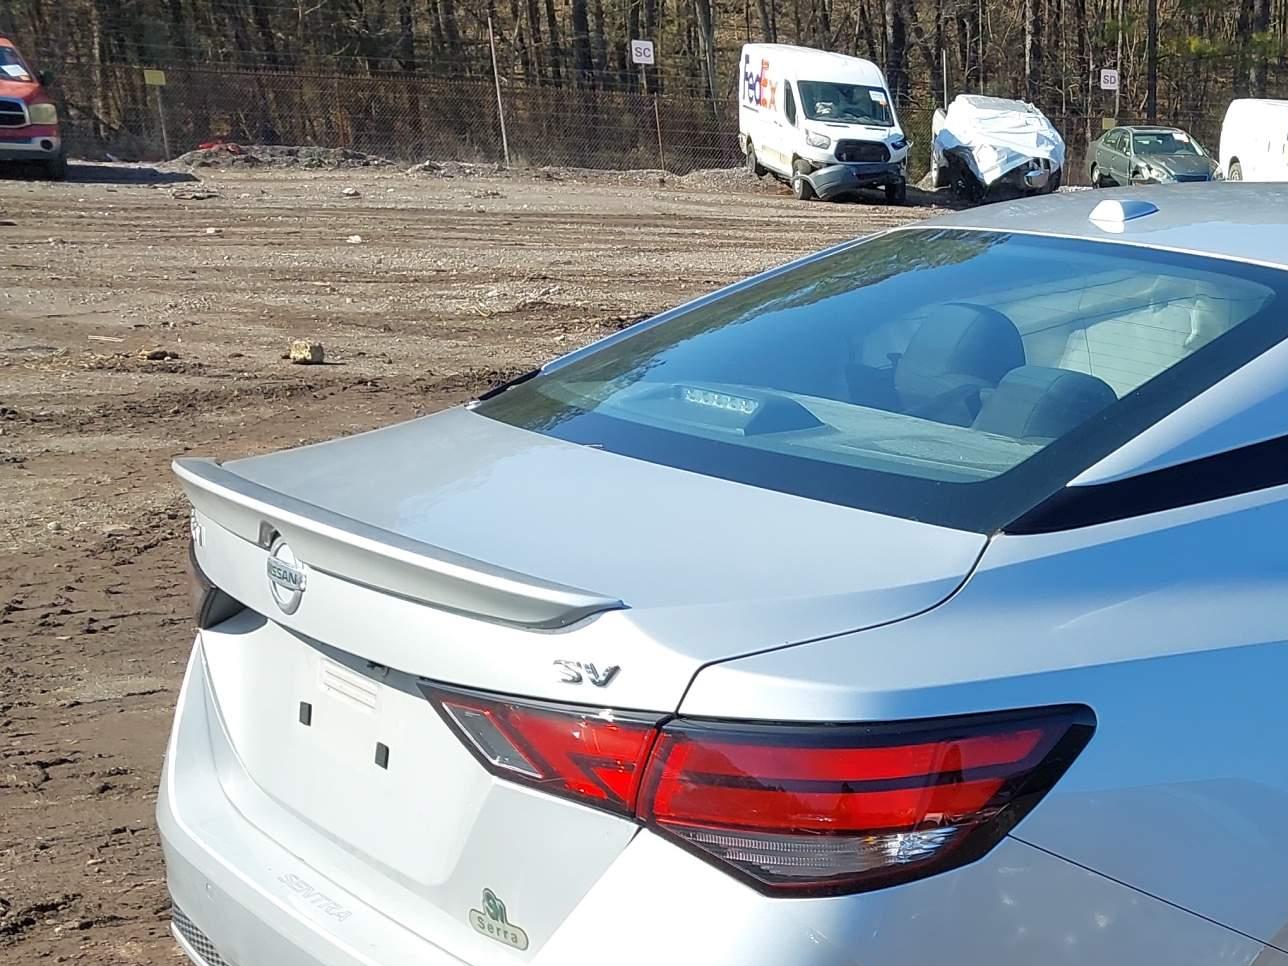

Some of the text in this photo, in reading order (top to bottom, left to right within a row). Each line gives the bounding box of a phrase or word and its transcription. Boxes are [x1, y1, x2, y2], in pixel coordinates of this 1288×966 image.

[634, 46, 651, 58] SC
[743, 54, 778, 112] FedEx
[1103, 74, 1116, 85] SD
[553, 659, 622, 687] SV
[277, 873, 353, 922] SENTRA
[476, 915, 519, 945] Serra
